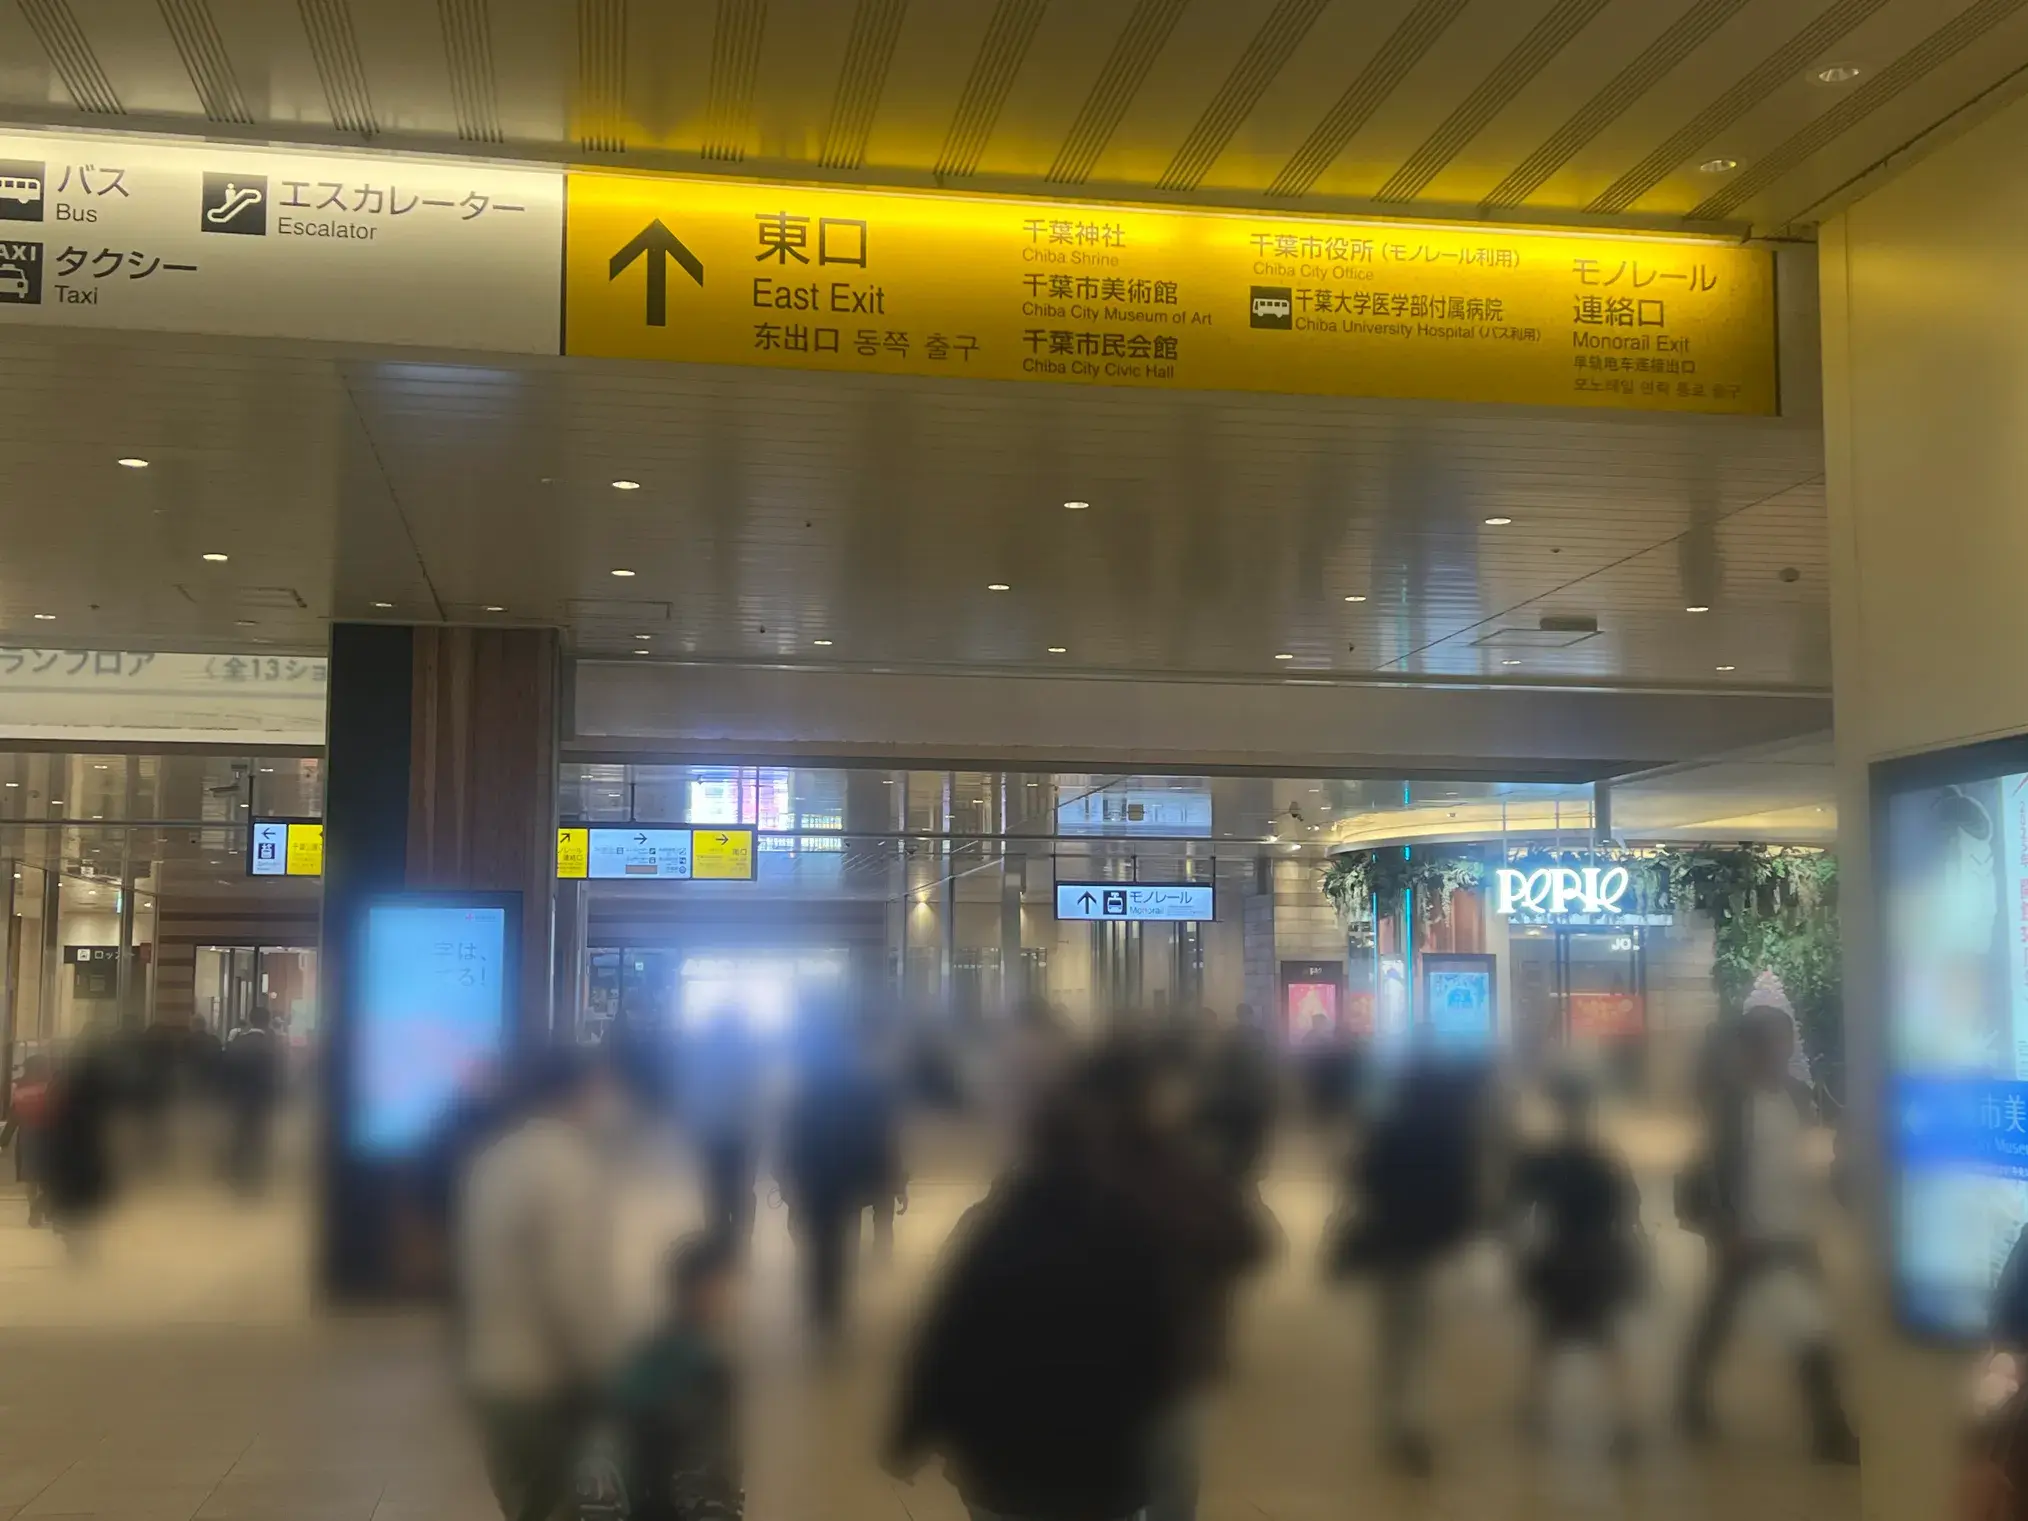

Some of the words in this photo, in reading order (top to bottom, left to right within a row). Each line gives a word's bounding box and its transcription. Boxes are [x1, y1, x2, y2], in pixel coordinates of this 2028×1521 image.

[58, 164, 130, 197] バス
[56, 203, 98, 222] Bus
[279, 180, 526, 221] エスカレーター
[277, 216, 378, 242] Escalator
[755, 210, 867, 268] 東口
[1023, 219, 1126, 248] 千葉神社
[56, 246, 197, 279] タクシー
[1022, 247, 1066, 264] Chiba
[1071, 250, 1120, 267] Shrine
[1250, 233, 1375, 263] 千葉市役所
[1253, 261, 1296, 277] Chiba
[1300, 264, 1328, 281] City
[1333, 265, 1375, 281] Office
[1572, 258, 1718, 292] モノレール
[54, 285, 99, 305] Taxi
[753, 277, 820, 310] East
[831, 282, 885, 315] Exit
[1023, 273, 1179, 306] 千葉市美術館
[1022, 301, 1066, 317] Chiba
[1071, 304, 1100, 323] City
[1105, 306, 1168, 323] Museum
[1172, 310, 1187, 324] of
[1191, 311, 1213, 326] Art
[1295, 288, 1504, 322] 千葉大学医学部付属病院
[1573, 294, 1665, 328] 連絡口
[753, 321, 840, 353] 东出口
[854, 329, 910, 358] 동쪽
[924, 332, 980, 362] 출구
[1295, 317, 1338, 333] Chiba
[1343, 319, 1414, 339] University
[1418, 323, 1475, 341] Hospital
[1572, 331, 1650, 351] Monorail
[1656, 335, 1690, 354] Exit
[1023, 328, 1179, 361] 千葉市民会館
[1022, 358, 1067, 374] Chiba
[1071, 360, 1100, 379] City
[1105, 362, 1142, 378] Civic
[1146, 364, 1175, 379] Hall
[1129, 891, 1193, 904] モノレール
